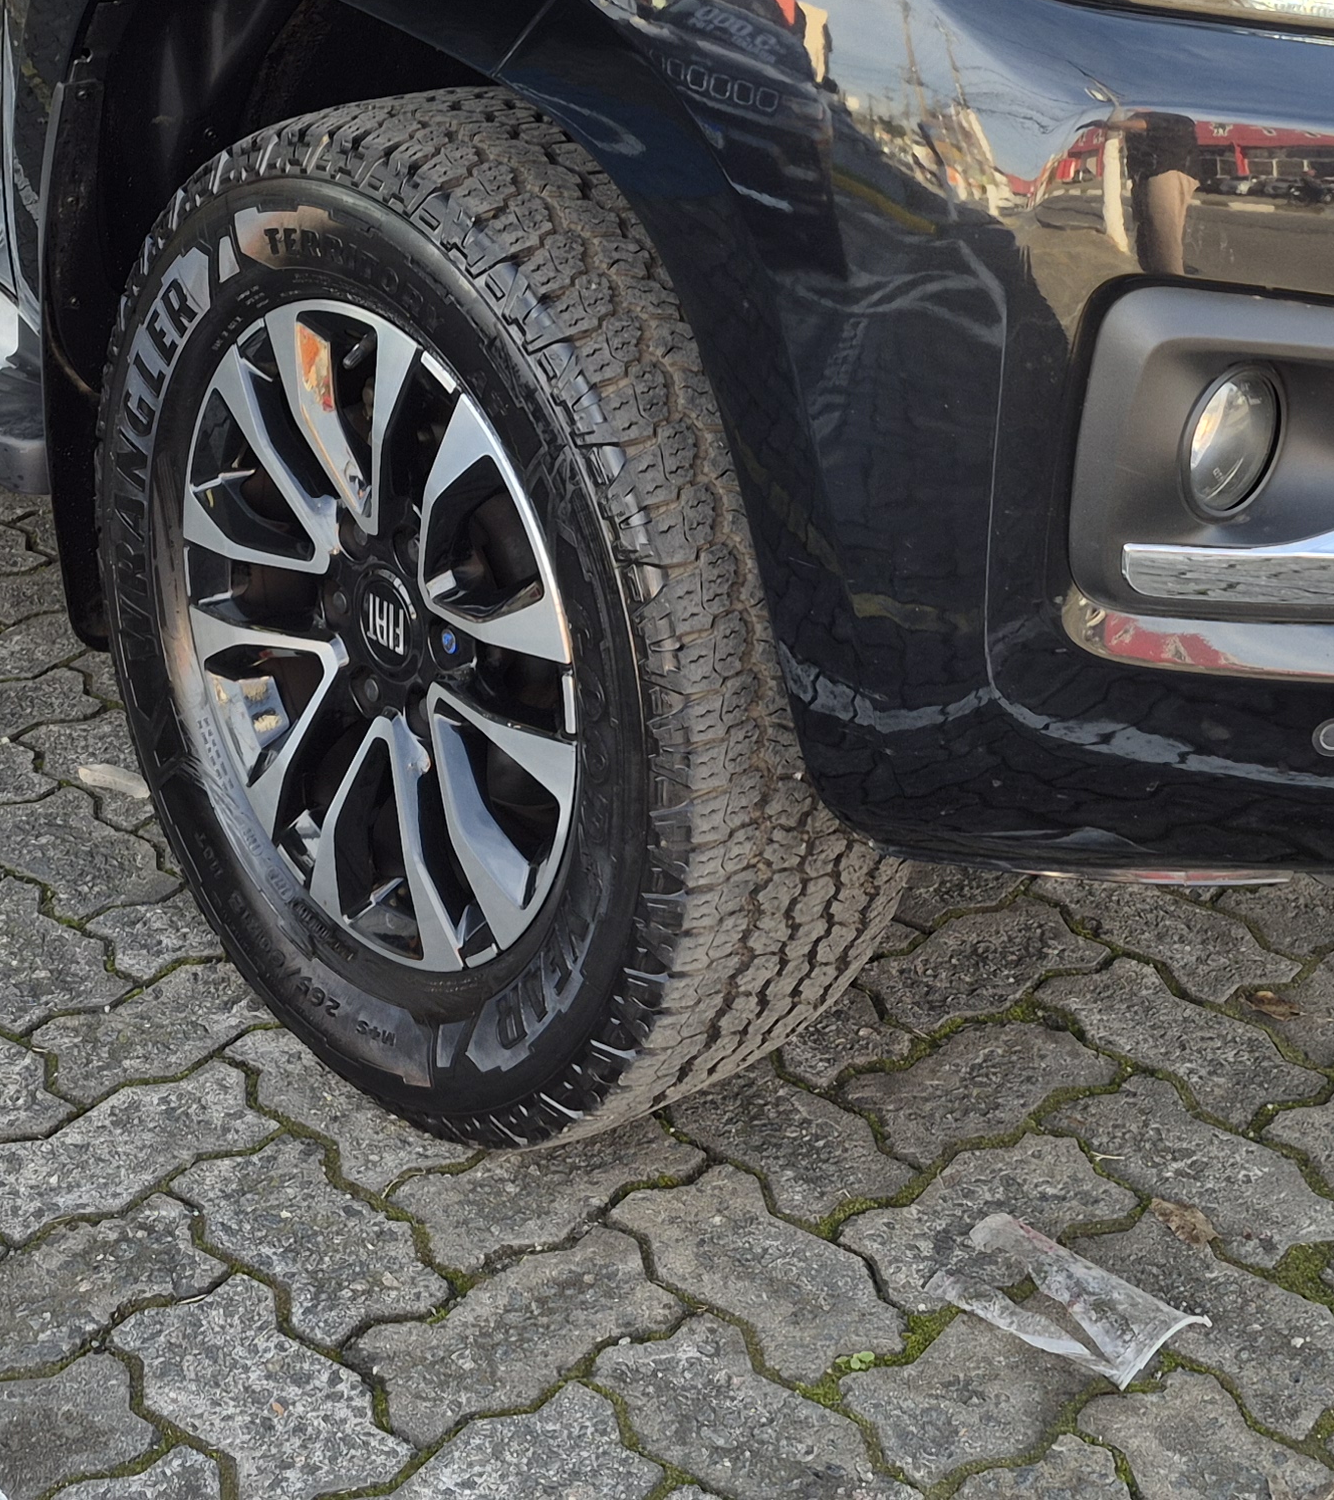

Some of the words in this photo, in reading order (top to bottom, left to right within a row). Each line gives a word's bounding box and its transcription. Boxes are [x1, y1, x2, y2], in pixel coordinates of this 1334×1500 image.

[263, 227, 445, 334] TERRITORY
[117, 278, 202, 663] WRANGLER
[367, 593, 404, 656] FIAT
